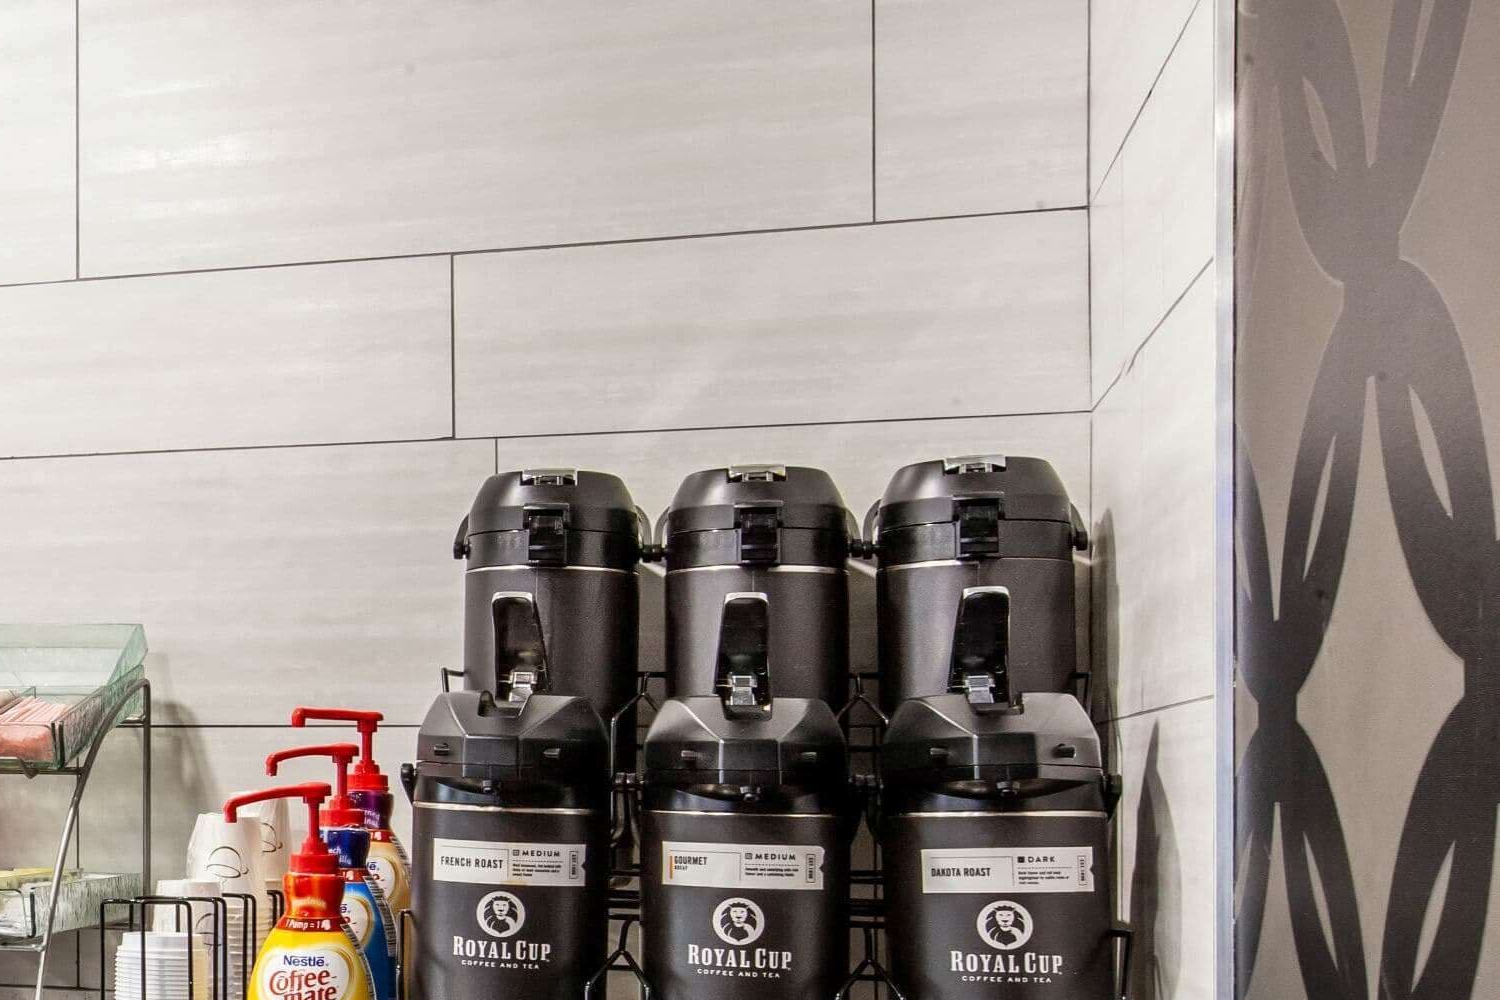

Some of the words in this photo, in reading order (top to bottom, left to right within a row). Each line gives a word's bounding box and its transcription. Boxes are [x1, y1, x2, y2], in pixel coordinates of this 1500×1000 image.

[440, 856, 471, 867] FRENCH
[475, 858, 503, 869] ROAST
[674, 856, 707, 866] GOURMET
[931, 868, 961, 877] DAKOTA
[963, 867, 991, 877] ROAST
[453, 935, 511, 960] ROYAL
[515, 940, 551, 961] CUP
[688, 944, 751, 968] ROYAL
[754, 948, 792, 970] CUP
[950, 951, 1019, 973] ROYAL
[1024, 952, 1063, 974] CUP
[461, 959, 495, 968] COFFEE
[697, 968, 734, 977] COFFEE
